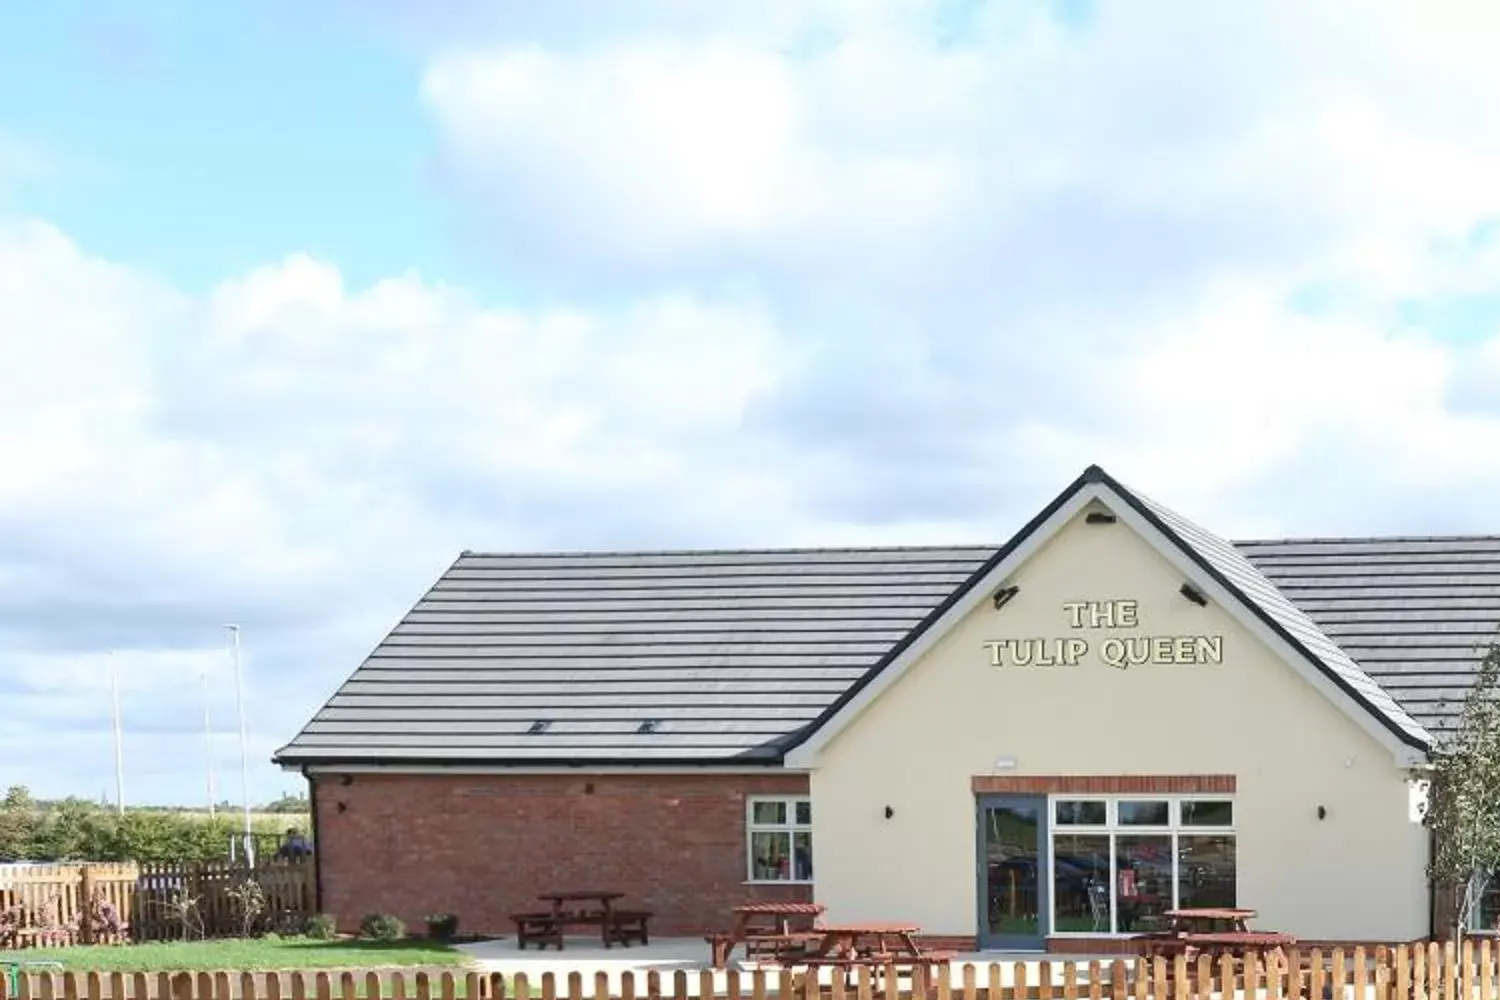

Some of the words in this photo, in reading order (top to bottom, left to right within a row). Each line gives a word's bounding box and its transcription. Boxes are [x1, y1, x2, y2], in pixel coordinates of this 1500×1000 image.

[1064, 600, 1138, 628] THE
[984, 638, 1089, 667] TULIP
[1100, 636, 1223, 670] QUEEN
